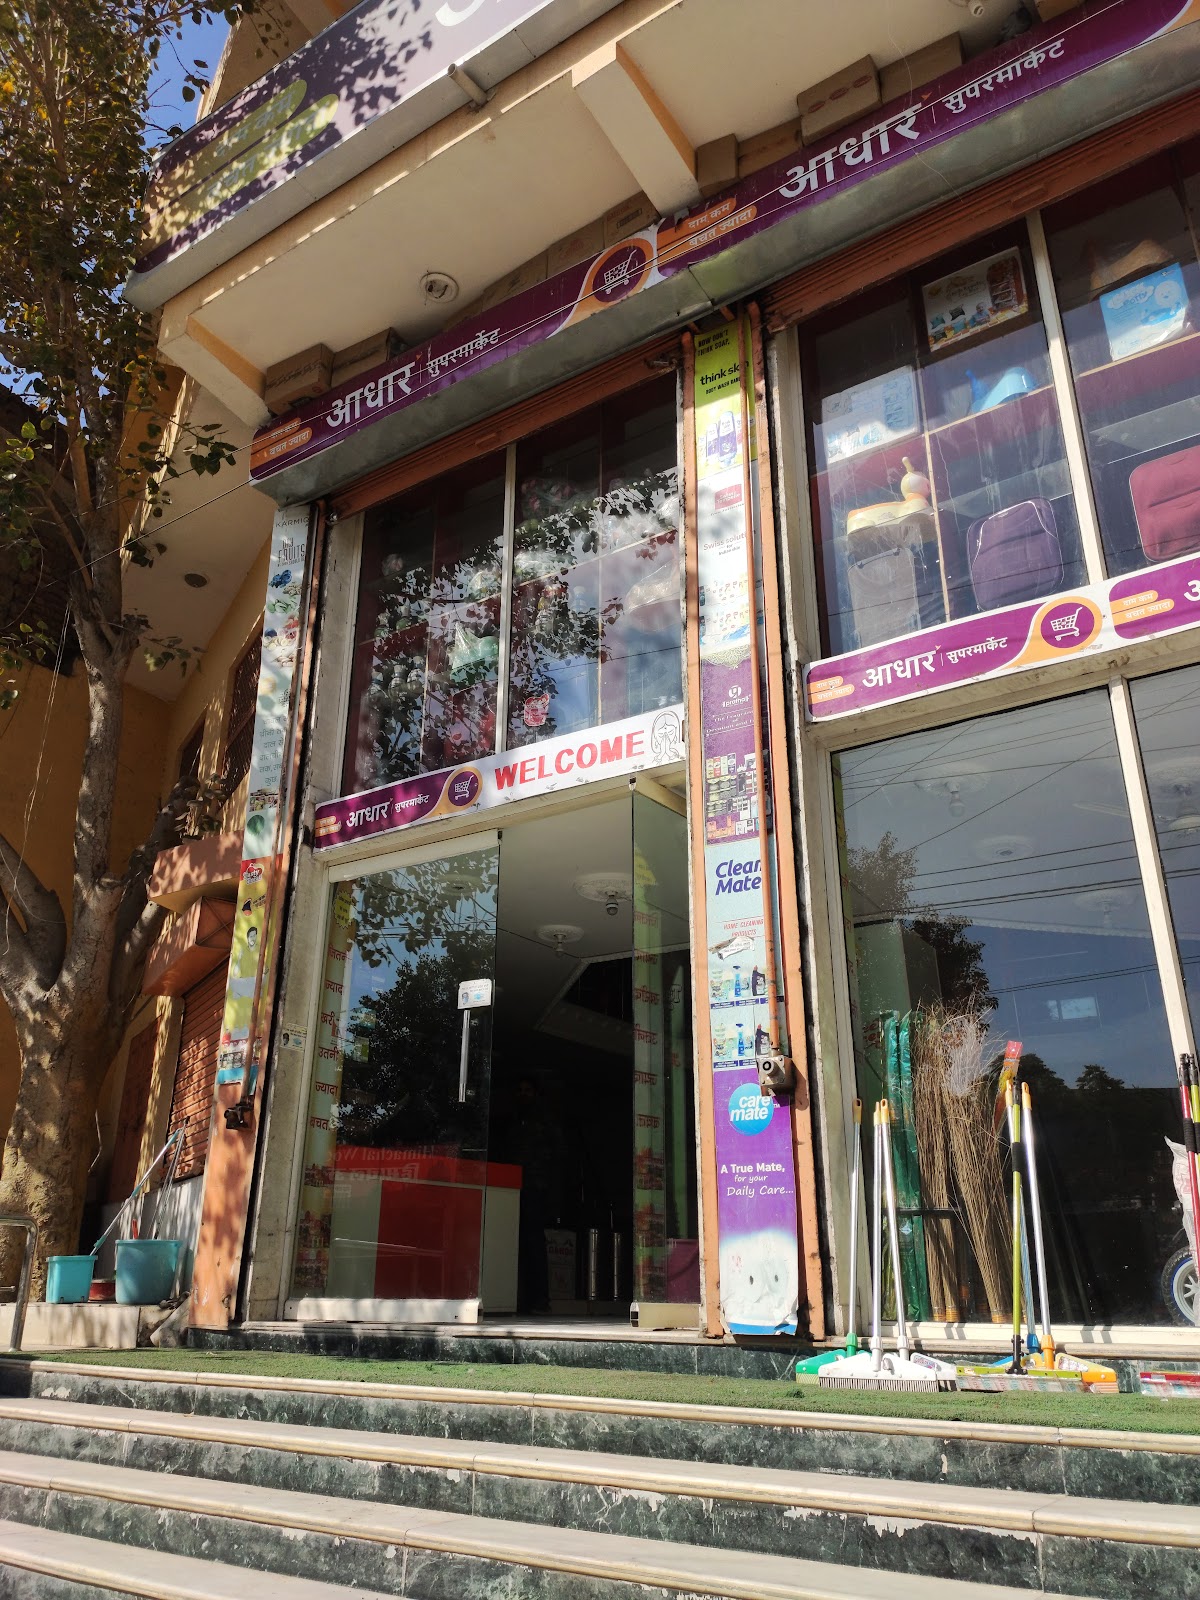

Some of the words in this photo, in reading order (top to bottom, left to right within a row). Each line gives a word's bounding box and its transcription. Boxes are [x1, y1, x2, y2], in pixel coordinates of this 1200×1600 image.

[778, 102, 922, 198] आधार
[687, 212, 708, 230] दाम
[710, 201, 732, 221] कम
[688, 226, 718, 247] बचत
[700, 368, 727, 386] think
[326, 362, 416, 428] आधार
[269, 441, 288, 456] बचत
[703, 539, 725, 551] Swiss
[862, 650, 938, 688] आधार
[946, 636, 1009, 665] सुपरमार्केट
[494, 730, 645, 792] WELCOME
[346, 799, 390, 828] आधार
[394, 793, 430, 813] सुपरमार्केट
[715, 859, 762, 880] Clean
[715, 876, 762, 896] Mate
[723, 922, 739, 930] HOME
[740, 918, 764, 928] CLEANING
[318, 1046, 340, 1061] उतनी
[315, 1081, 338, 1097] ज्यादा
[738, 1095, 771, 1108] care
[730, 1106, 769, 1122] mate
[720, 1164, 728, 1174] A
[730, 1163, 754, 1174] True
[756, 1162, 785, 1174] Mate,
[734, 1174, 746, 1182] for
[748, 1174, 769, 1184] your
[727, 1185, 755, 1198] Daily
[759, 1185, 794, 1195] Care...
